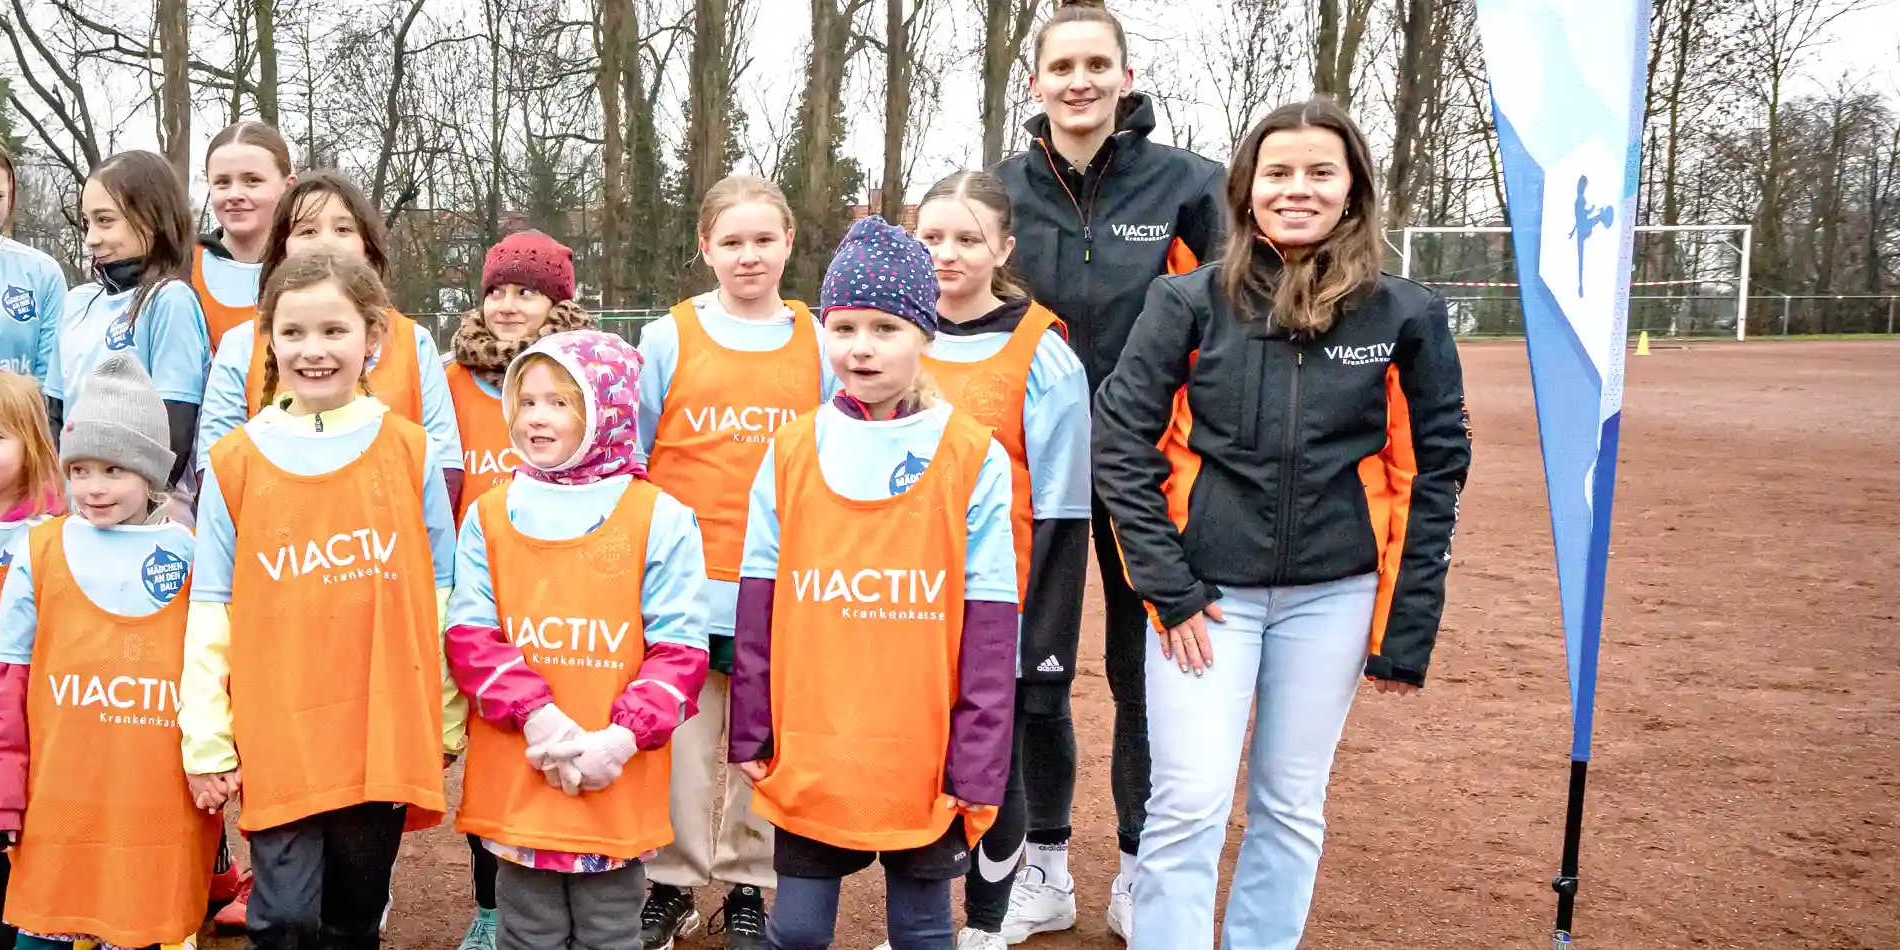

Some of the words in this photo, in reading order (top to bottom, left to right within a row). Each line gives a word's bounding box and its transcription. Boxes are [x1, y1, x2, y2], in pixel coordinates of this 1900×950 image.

[1112, 222, 1169, 236] VIACTIV
[1323, 342, 1396, 360] VIACTIV
[256, 528, 397, 581] VIACTIV
[146, 562, 183, 576] MÄDCHEN
[154, 573, 165, 584] AN
[166, 571, 180, 582] DEN
[160, 581, 178, 592] BALL
[791, 568, 947, 604] VIACTIV
[842, 607, 945, 621] Krankenkasse
[504, 616, 630, 653] IACTIV
[100, 711, 180, 728] Krankenkas
